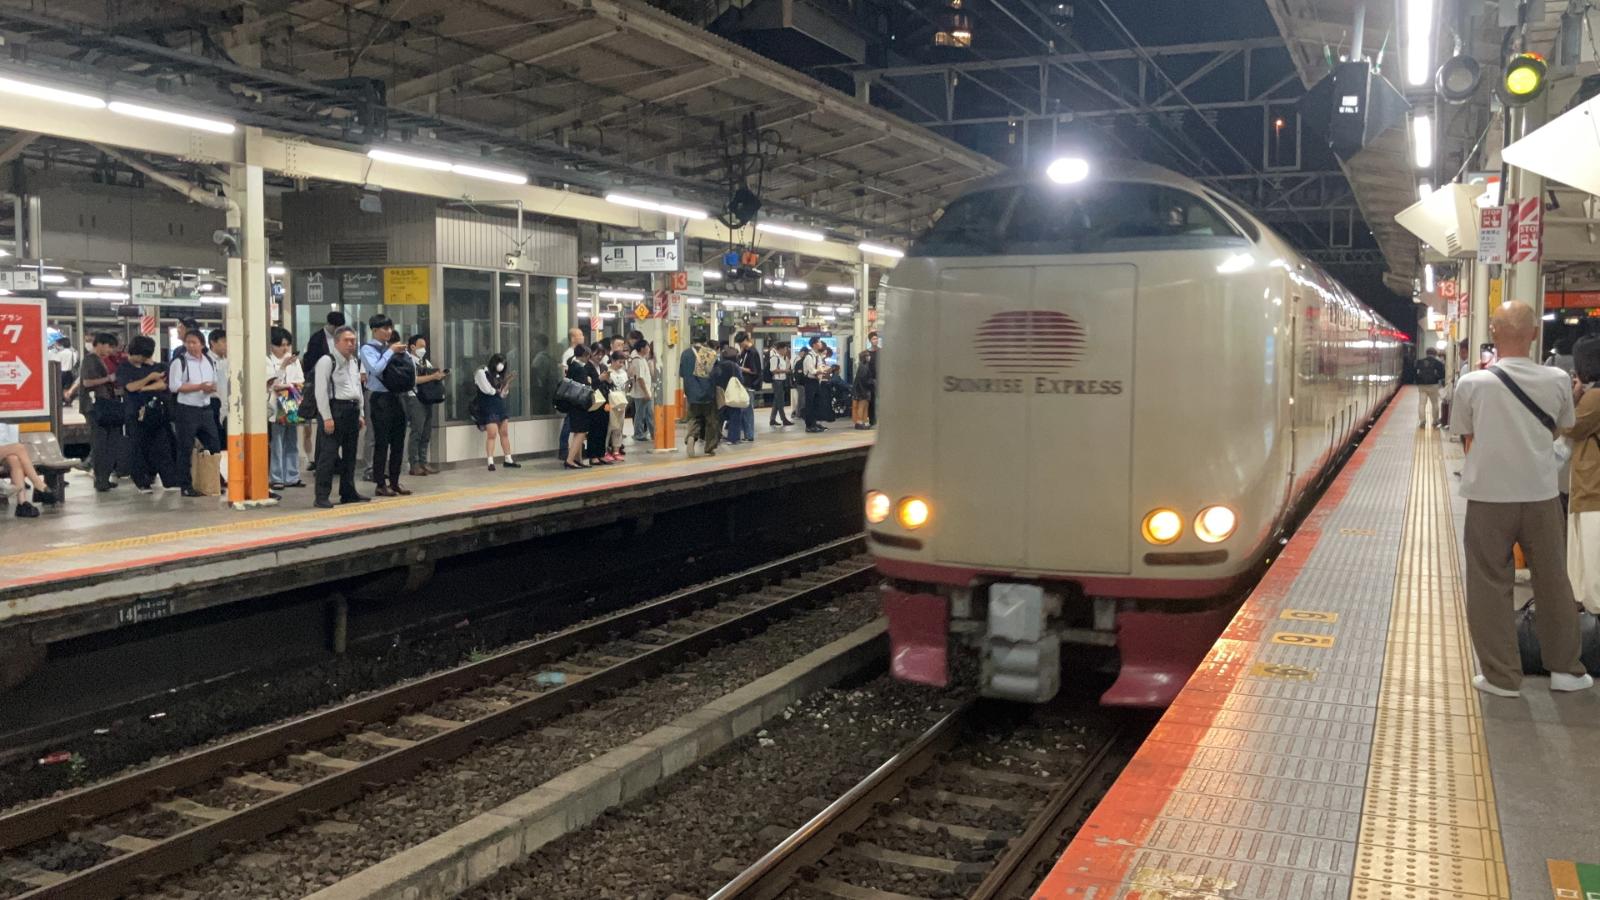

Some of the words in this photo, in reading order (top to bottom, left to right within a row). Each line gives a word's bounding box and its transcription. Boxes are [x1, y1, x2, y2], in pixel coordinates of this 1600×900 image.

[343, 272, 377, 283] エレベーター
[671, 272, 687, 289] 13
[1439, 282, 1454, 296] 13
[1035, 377, 1122, 394] EXPRESS
